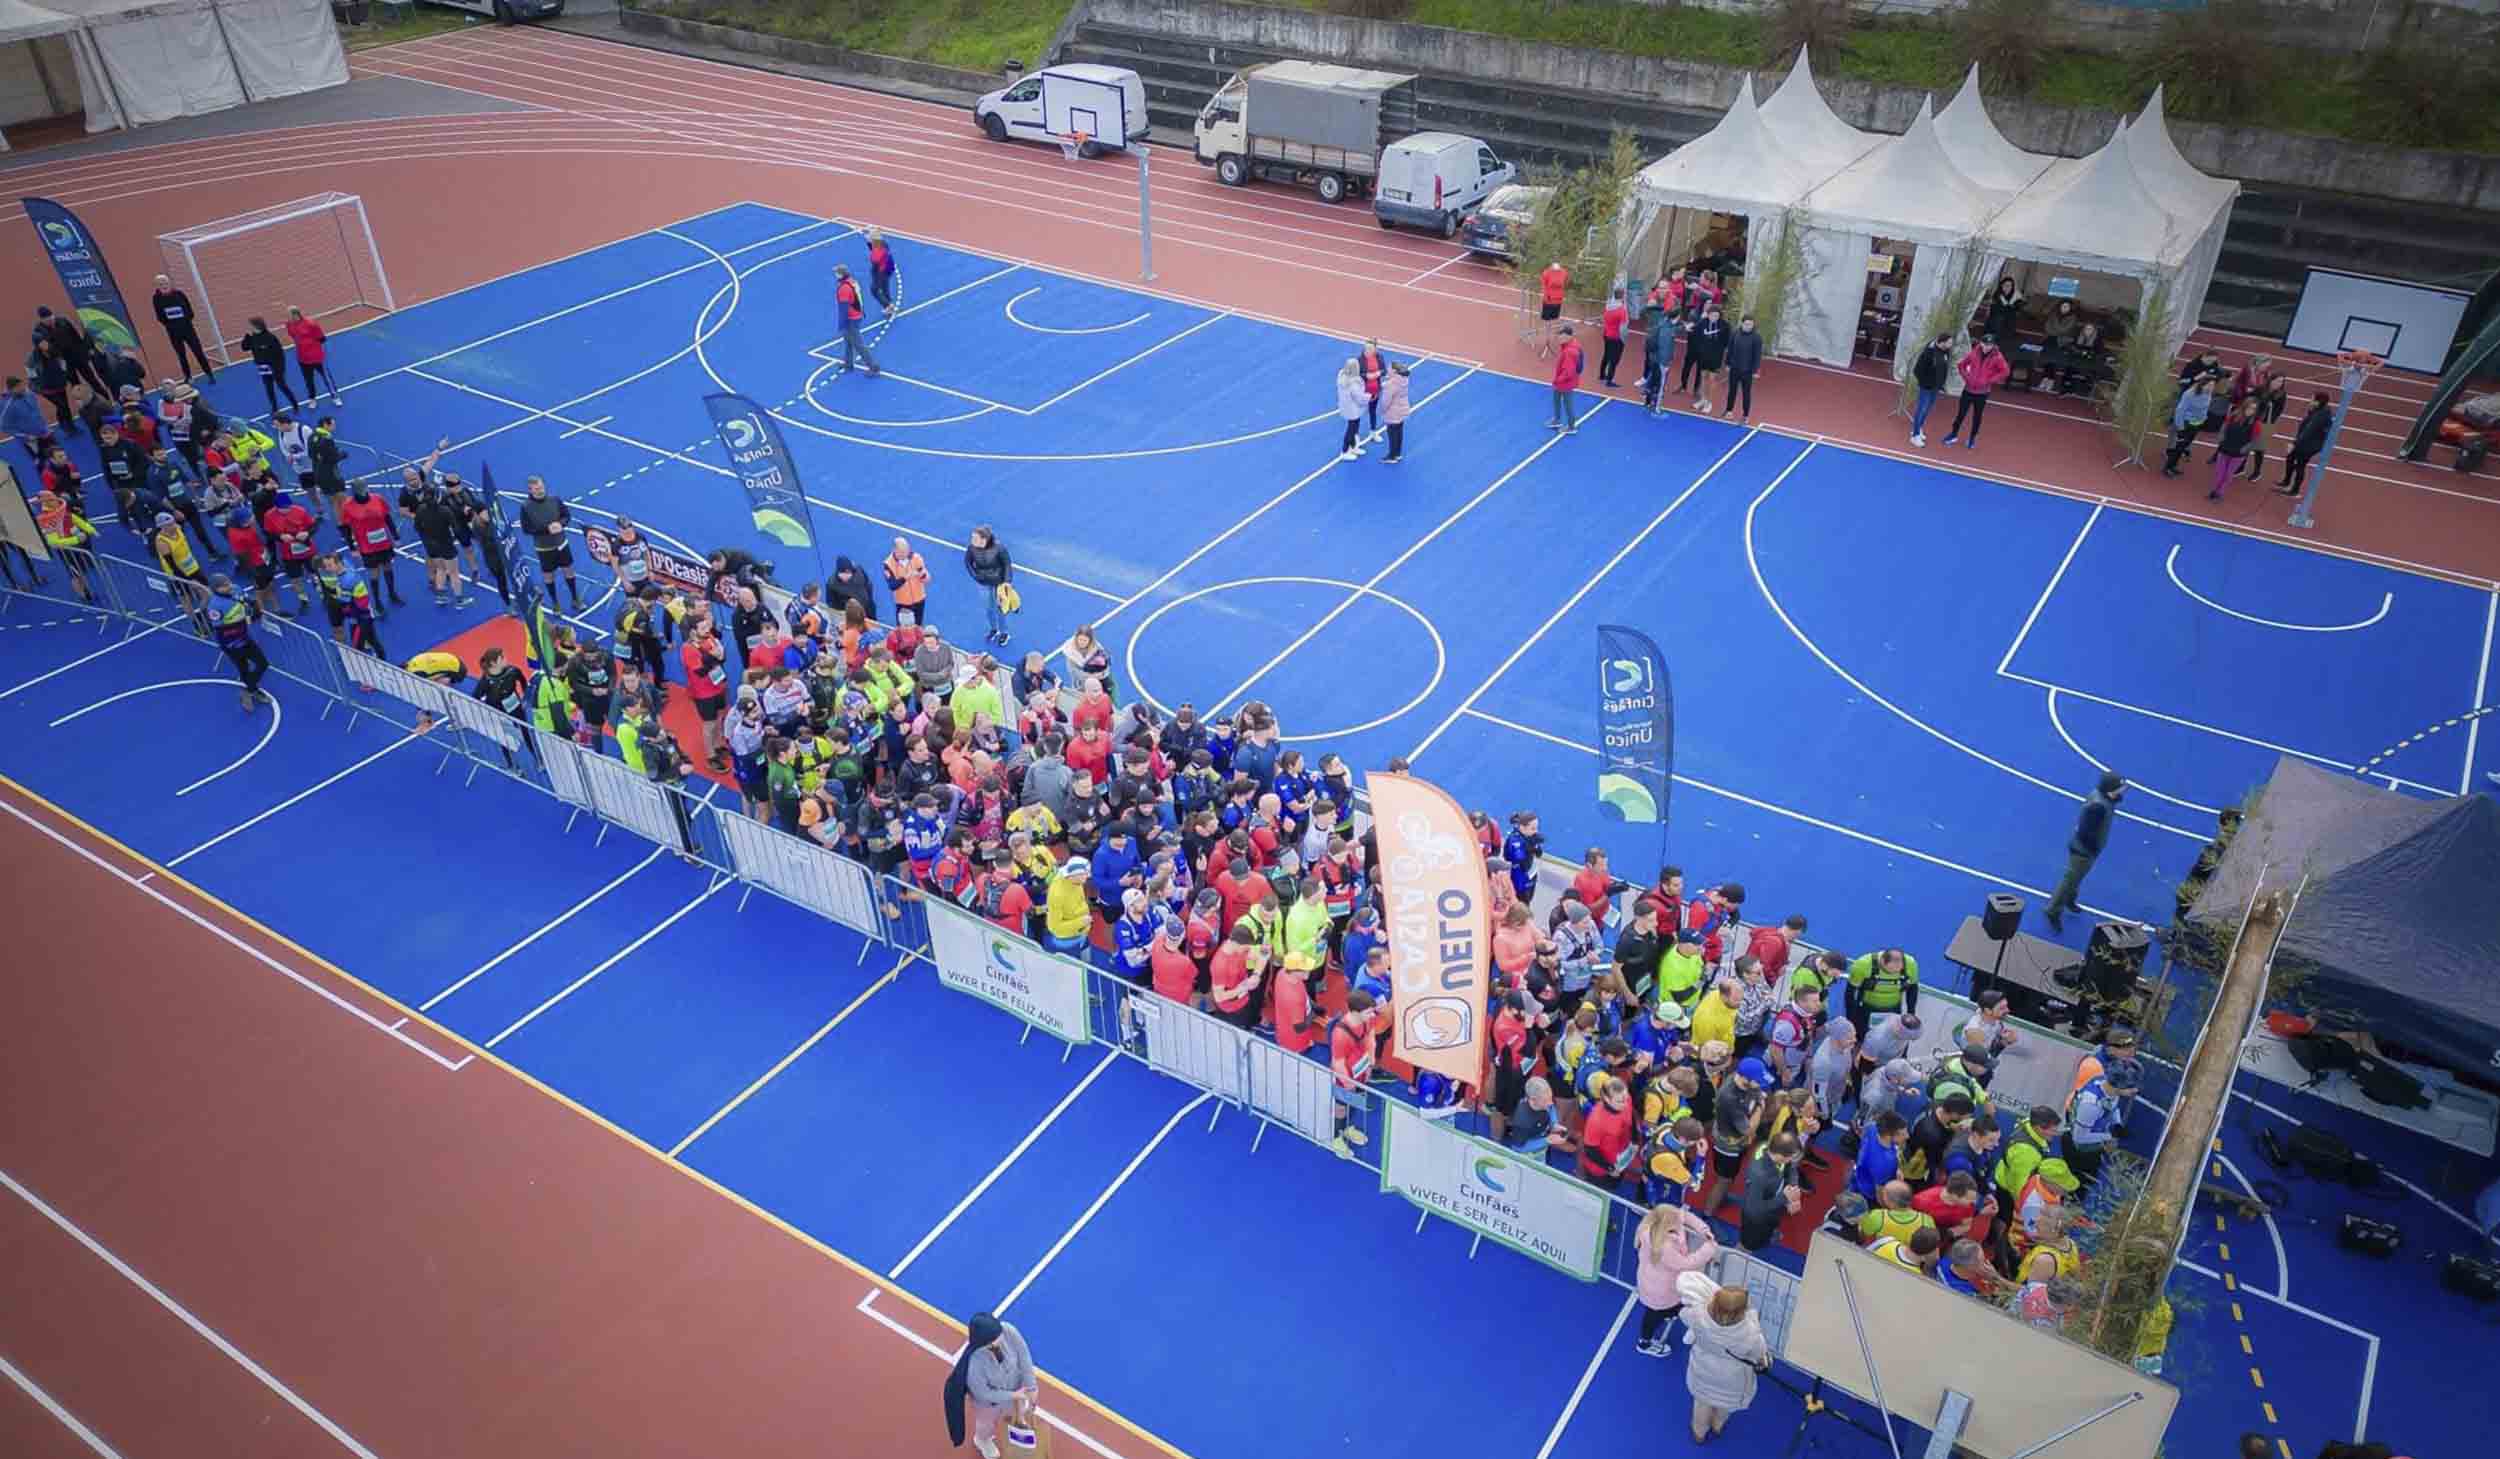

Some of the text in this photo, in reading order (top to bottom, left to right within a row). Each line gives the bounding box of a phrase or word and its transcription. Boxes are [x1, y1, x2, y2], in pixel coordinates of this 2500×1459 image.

[947, 969, 978, 985] VIVER
[990, 986, 1008, 999] SER
[1011, 995, 1036, 1016] FELIZ
[1409, 1183, 1450, 1206] VIVER
[1452, 1200, 1460, 1212] E
[1464, 1206, 1488, 1224] SER
[1493, 1219, 1528, 1242] FELIZ
